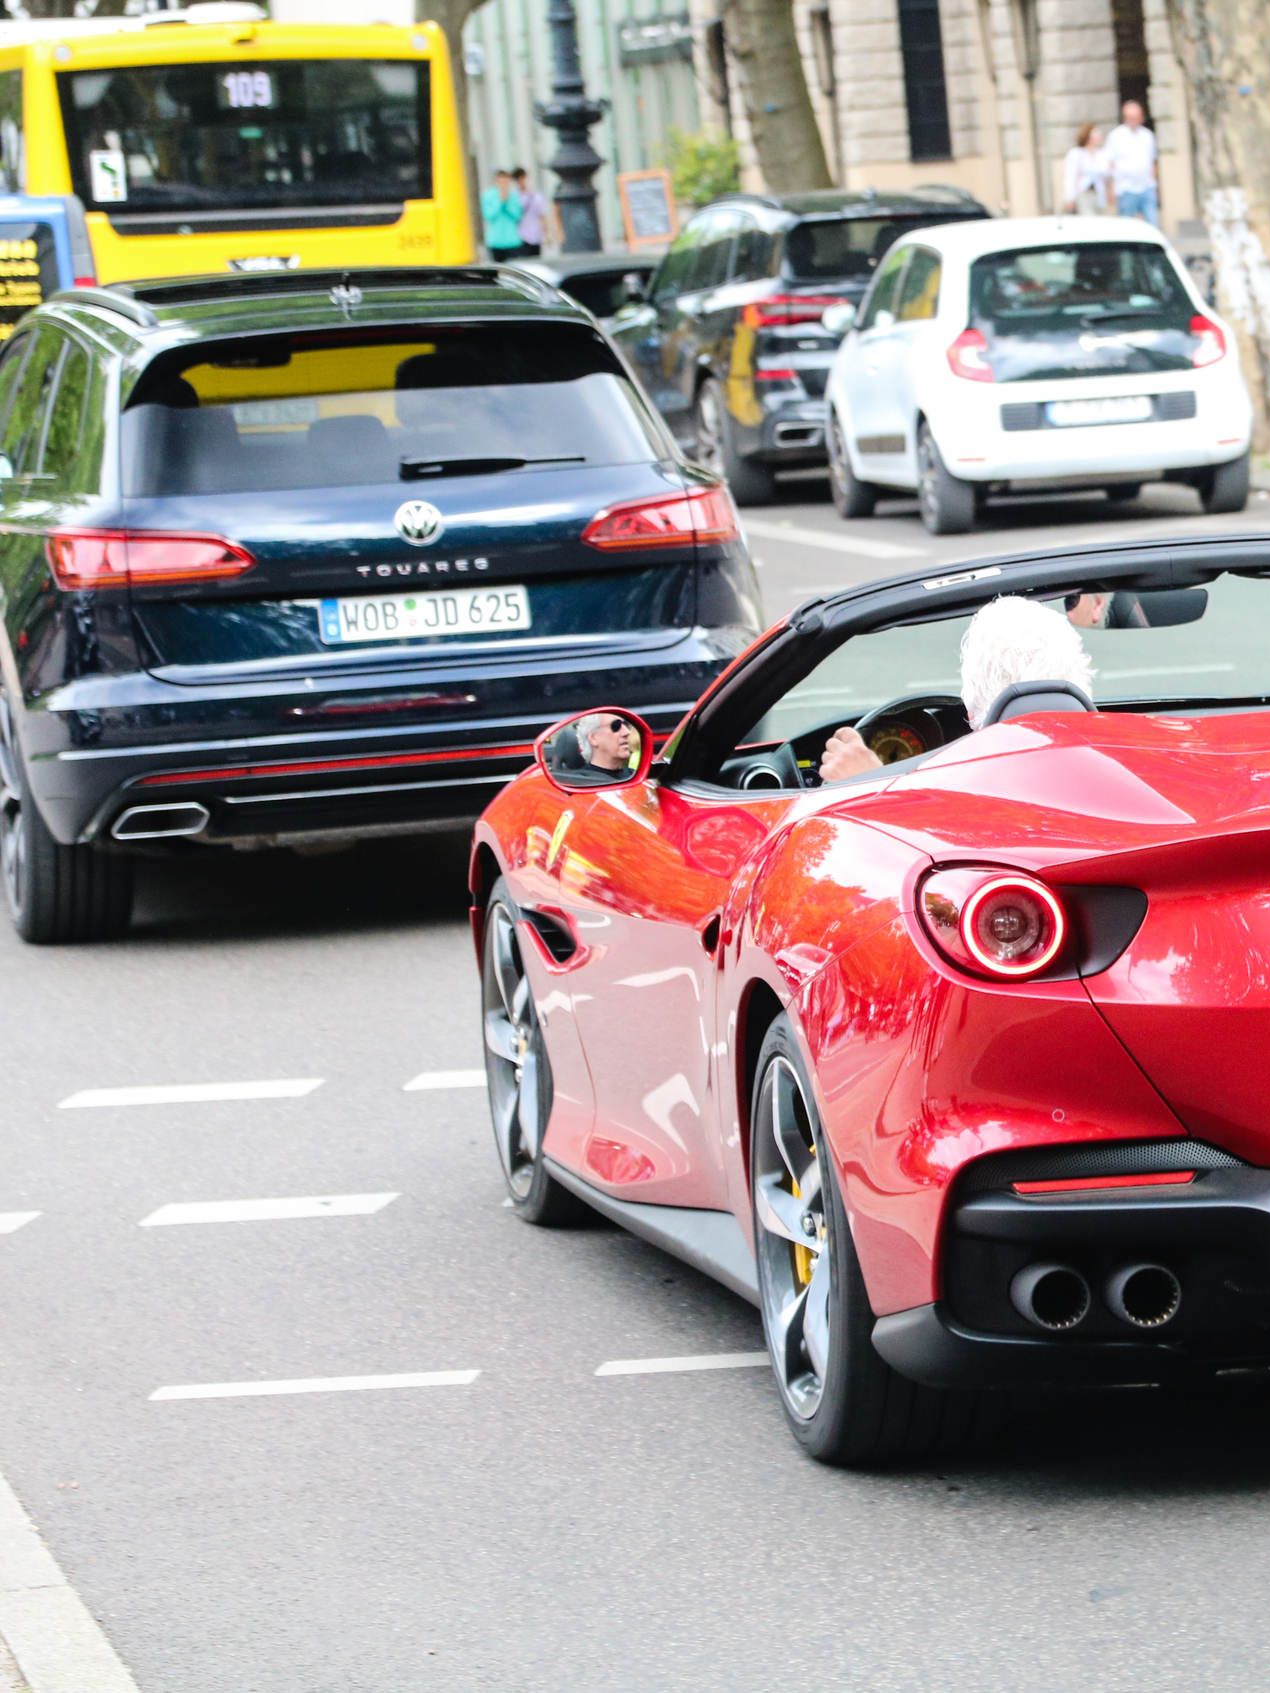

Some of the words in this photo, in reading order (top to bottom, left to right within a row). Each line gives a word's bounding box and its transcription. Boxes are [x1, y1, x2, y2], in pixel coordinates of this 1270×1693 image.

[222, 70, 272, 108] 109
[356, 556, 490, 578] TOUAREG
[342, 601, 400, 633] WOB
[424, 597, 459, 628] JD
[468, 592, 522, 624] 625
